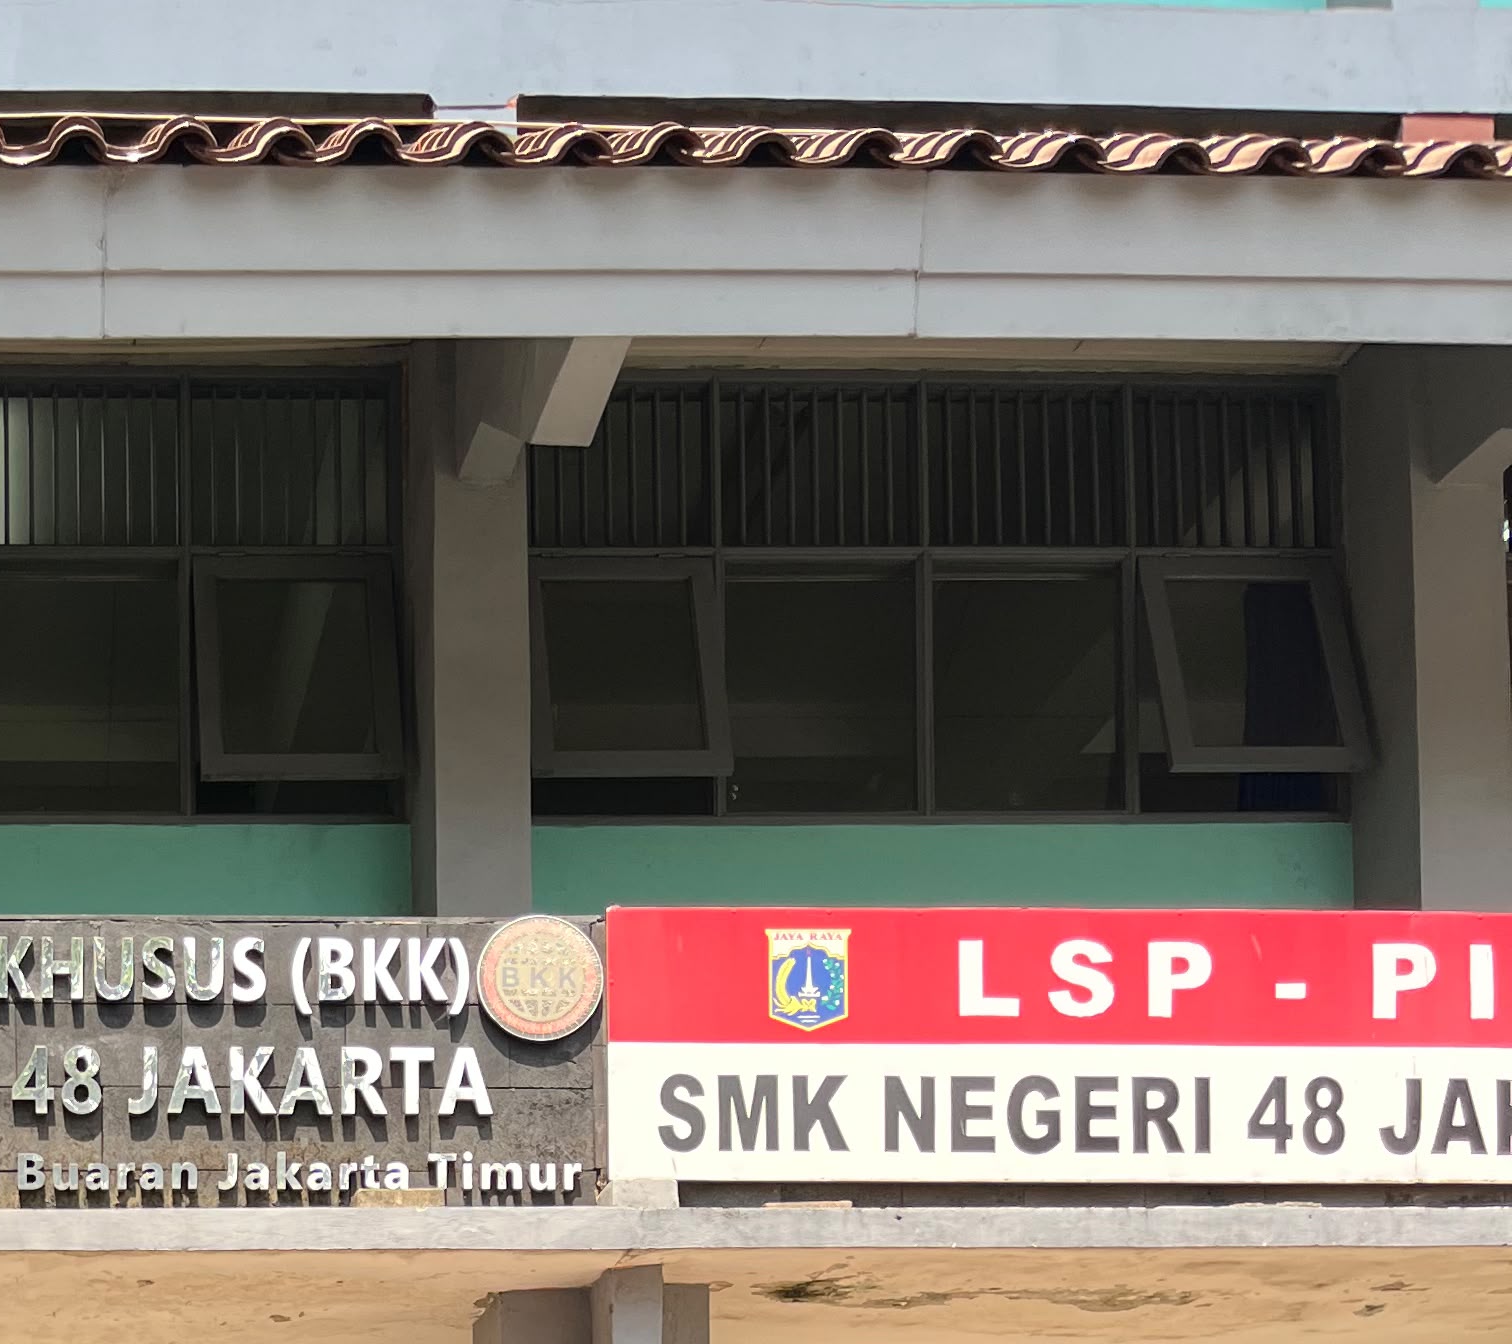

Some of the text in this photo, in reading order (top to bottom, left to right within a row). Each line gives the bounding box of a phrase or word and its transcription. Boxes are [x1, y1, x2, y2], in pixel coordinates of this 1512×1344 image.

[773, 932, 843, 941] JAYA RAYA
[290, 935, 471, 1017] (BKK)
[957, 939, 1213, 1018] LSP
[1371, 942, 1495, 1020] PI
[10, 1044, 102, 1116] 48
[127, 1045, 494, 1118] JAKARTA
[657, 1073, 1512, 1156] SMK NEGERI 48 JA
[16, 1151, 199, 1192] Buaran
[217, 1151, 410, 1192] Jakarta
[426, 1151, 584, 1192] Timur
